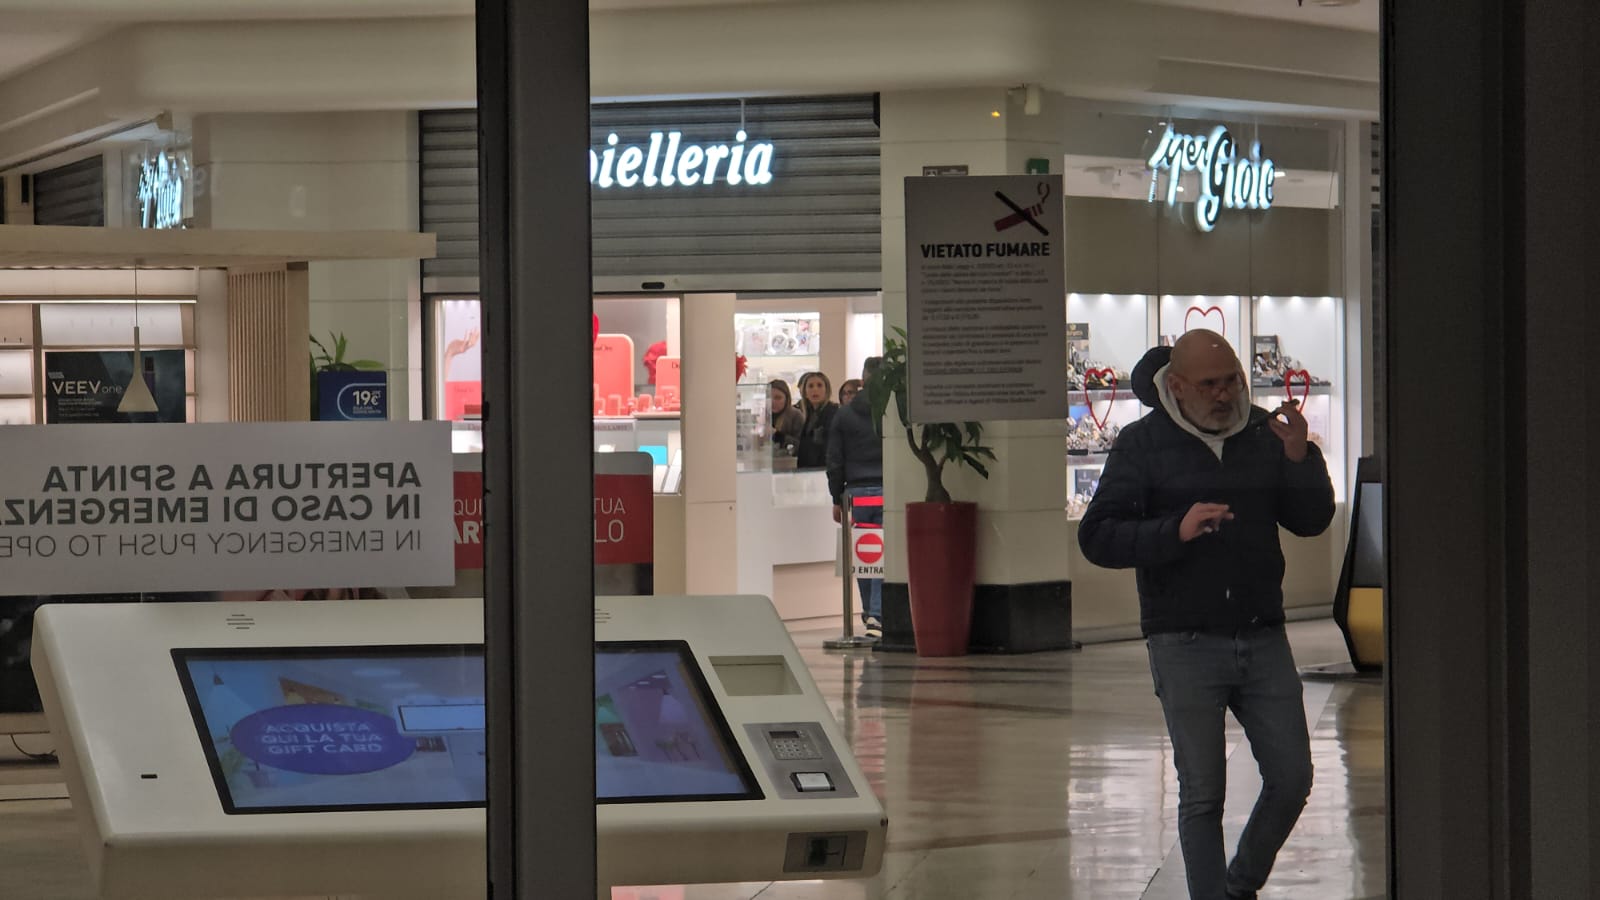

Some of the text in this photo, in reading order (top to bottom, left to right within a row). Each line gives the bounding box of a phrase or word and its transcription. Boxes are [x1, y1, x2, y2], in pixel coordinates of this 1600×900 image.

[921, 242, 1050, 258] VIETATO FUMARE
[52, 380, 101, 395] VEEV
[266, 722, 371, 734] ACQUISTA
[261, 733, 383, 744] QUI LA TUA
[268, 743, 383, 755] GIFT CARD
